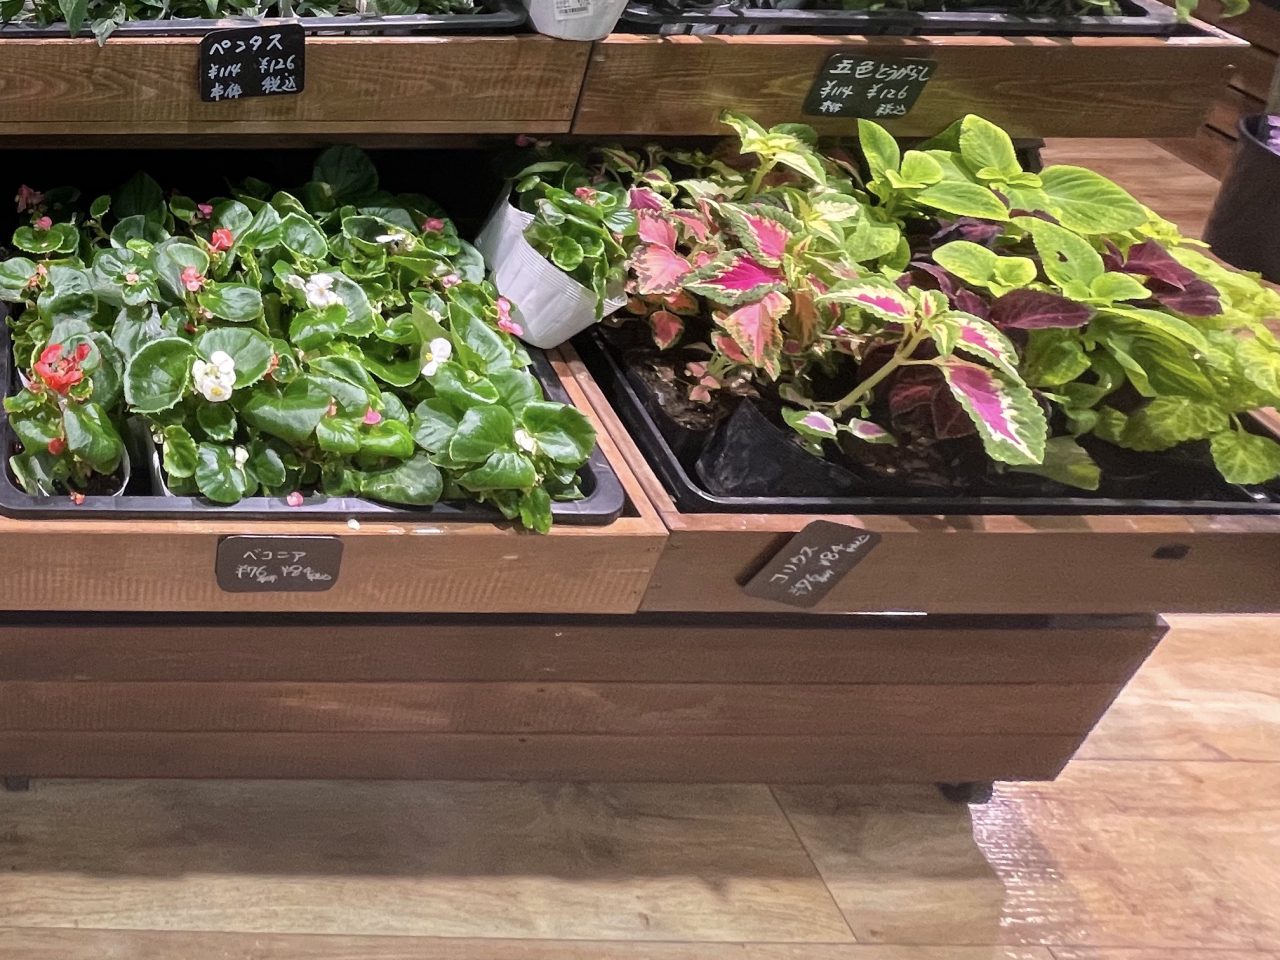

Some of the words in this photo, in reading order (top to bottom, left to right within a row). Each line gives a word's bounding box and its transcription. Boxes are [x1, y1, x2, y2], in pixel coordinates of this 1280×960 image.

[209, 33, 284, 56] ペンタス
[208, 62, 242, 80] ¥114
[258, 54, 296, 74] ¥126
[829, 59, 930, 81] 五色とうがらし
[866, 82, 910, 100] ¥126
[769, 545, 819, 584] コリウス
